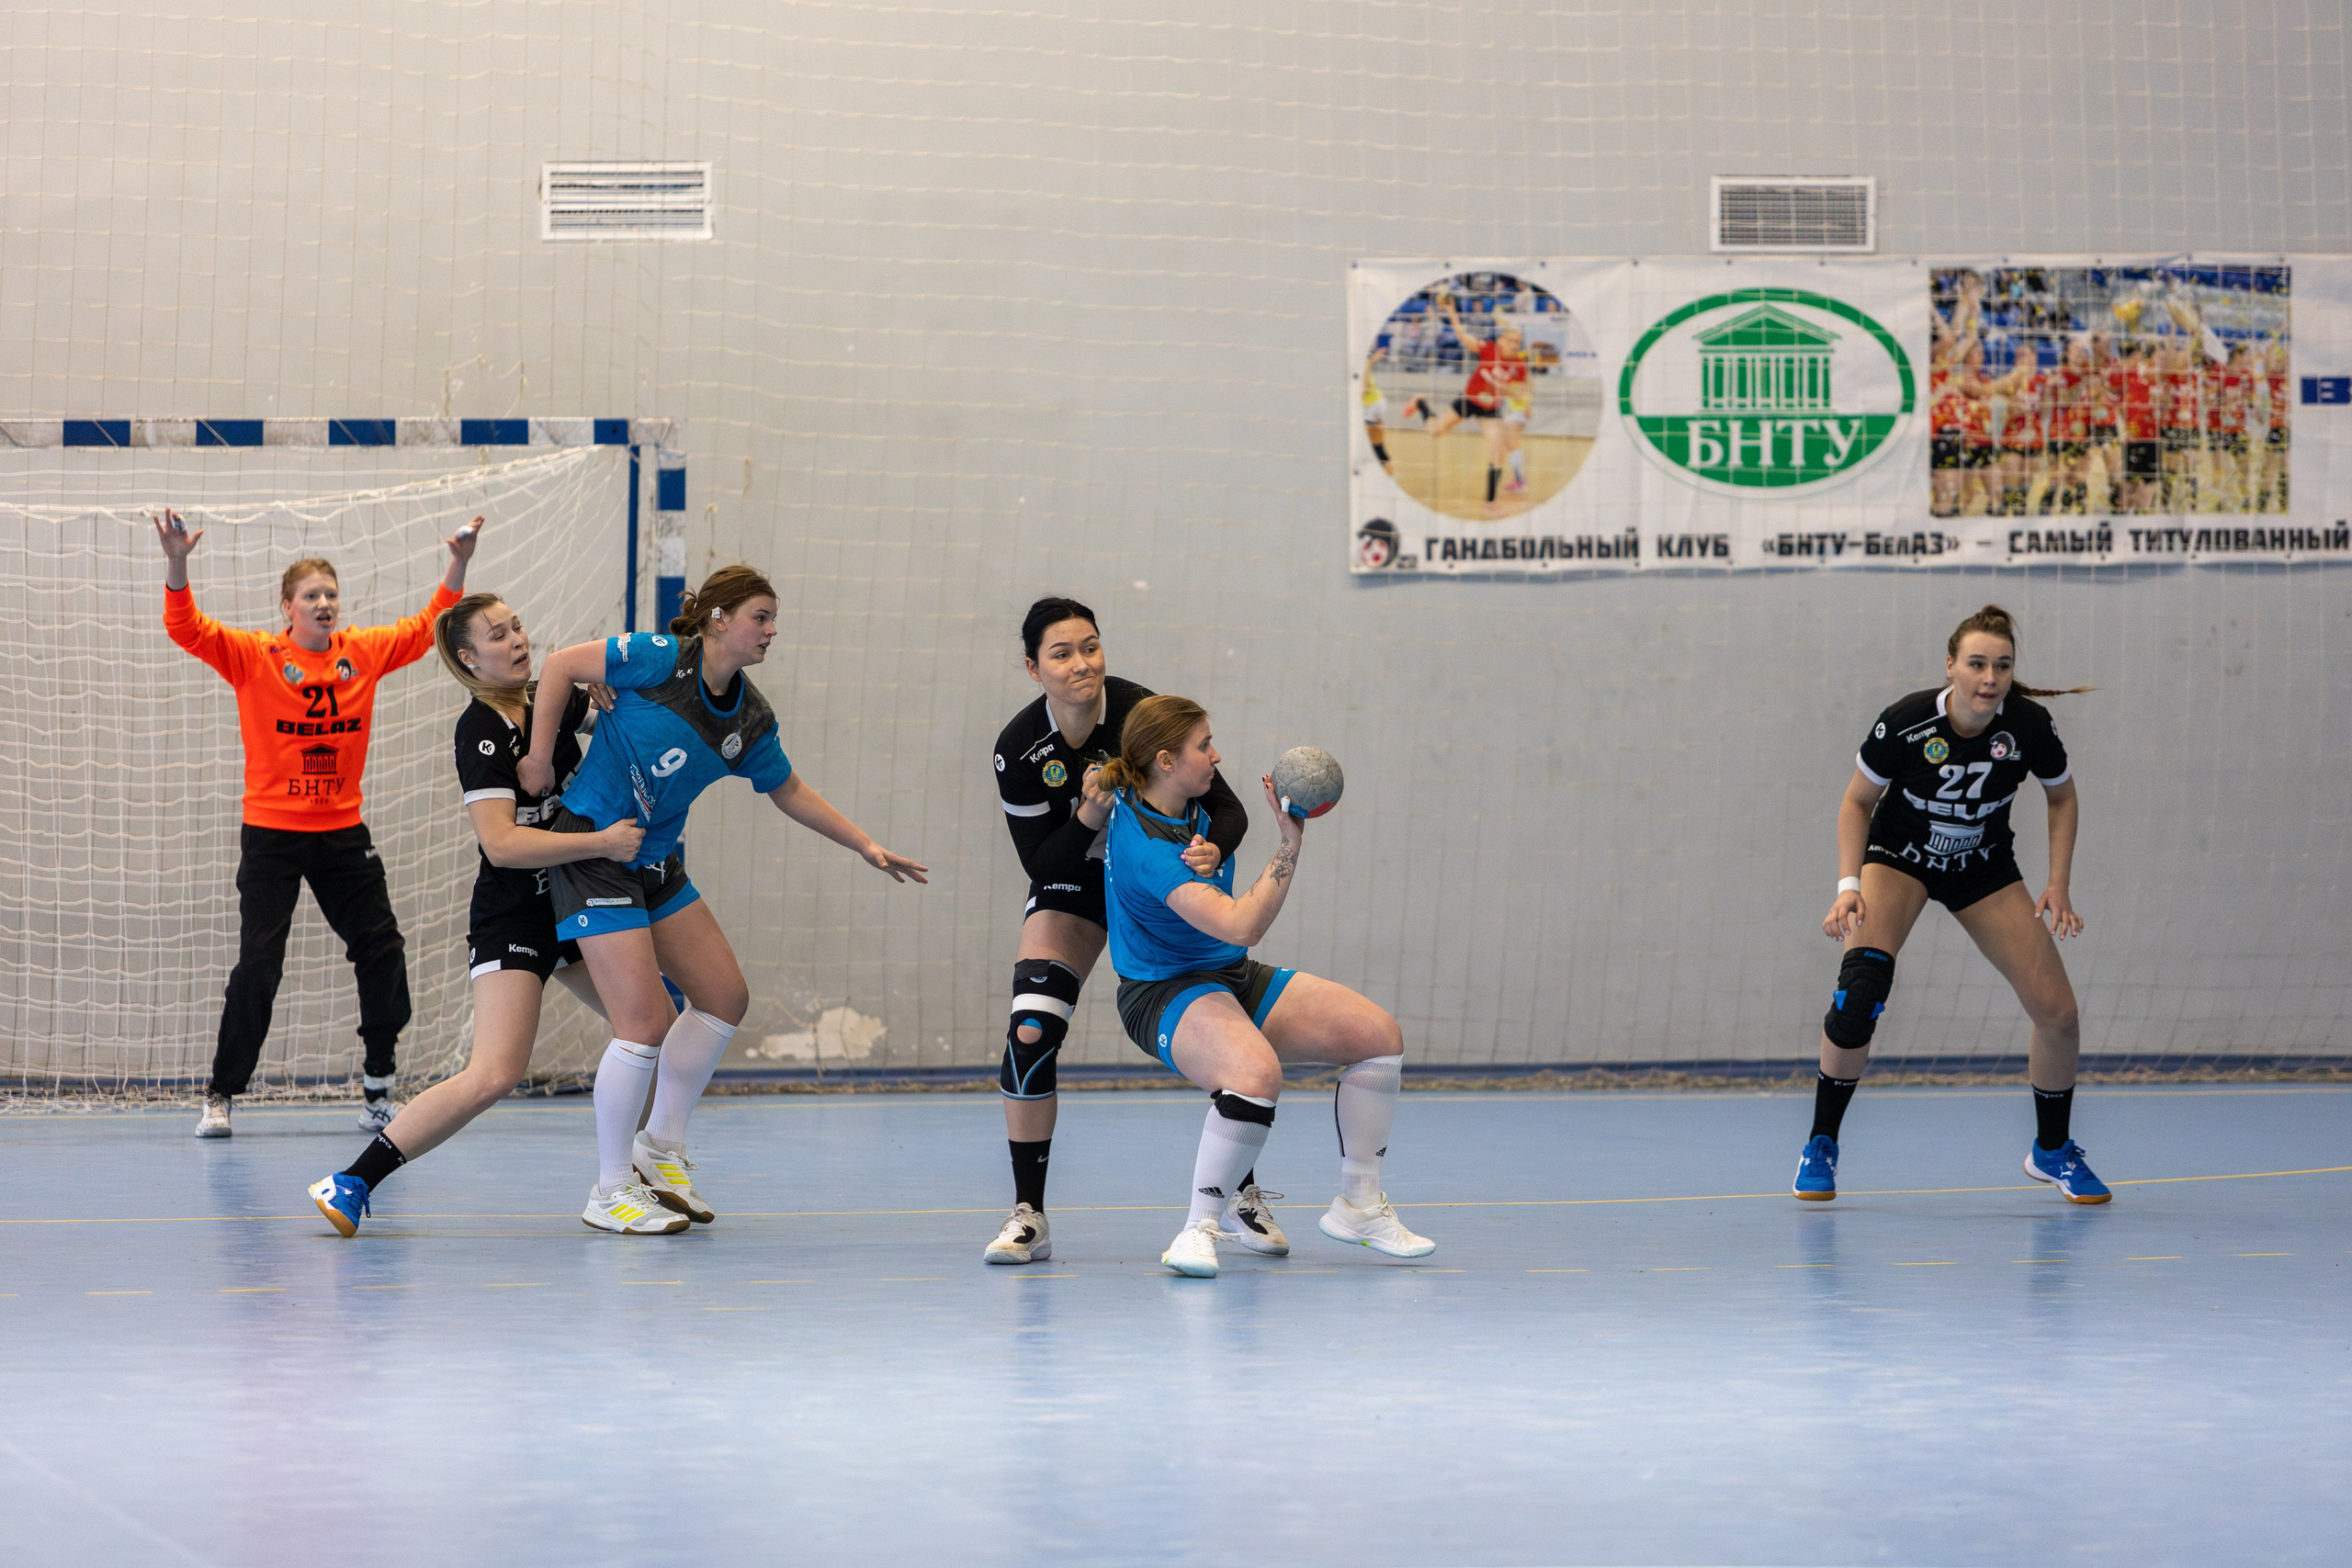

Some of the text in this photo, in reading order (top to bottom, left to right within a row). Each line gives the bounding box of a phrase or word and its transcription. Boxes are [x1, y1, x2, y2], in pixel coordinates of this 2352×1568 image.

[1686, 420, 1861, 467] БНТУ
[1426, 526, 1641, 560] ГАНДБОЛЬНЫЙ
[1657, 533, 1729, 558] КЛУБ
[2008, 521, 2112, 553] САМЫЙ
[2128, 519, 2350, 551] ТИТУЛОВАННЫЙ
[301, 684, 339, 717] 21
[277, 717, 362, 736] BELAZ
[1906, 726, 1937, 743] Kempa
[650, 747, 688, 778] 9
[288, 777, 345, 795] БНТУ
[1936, 761, 1993, 799] 27
[508, 943, 538, 957] Kempa
